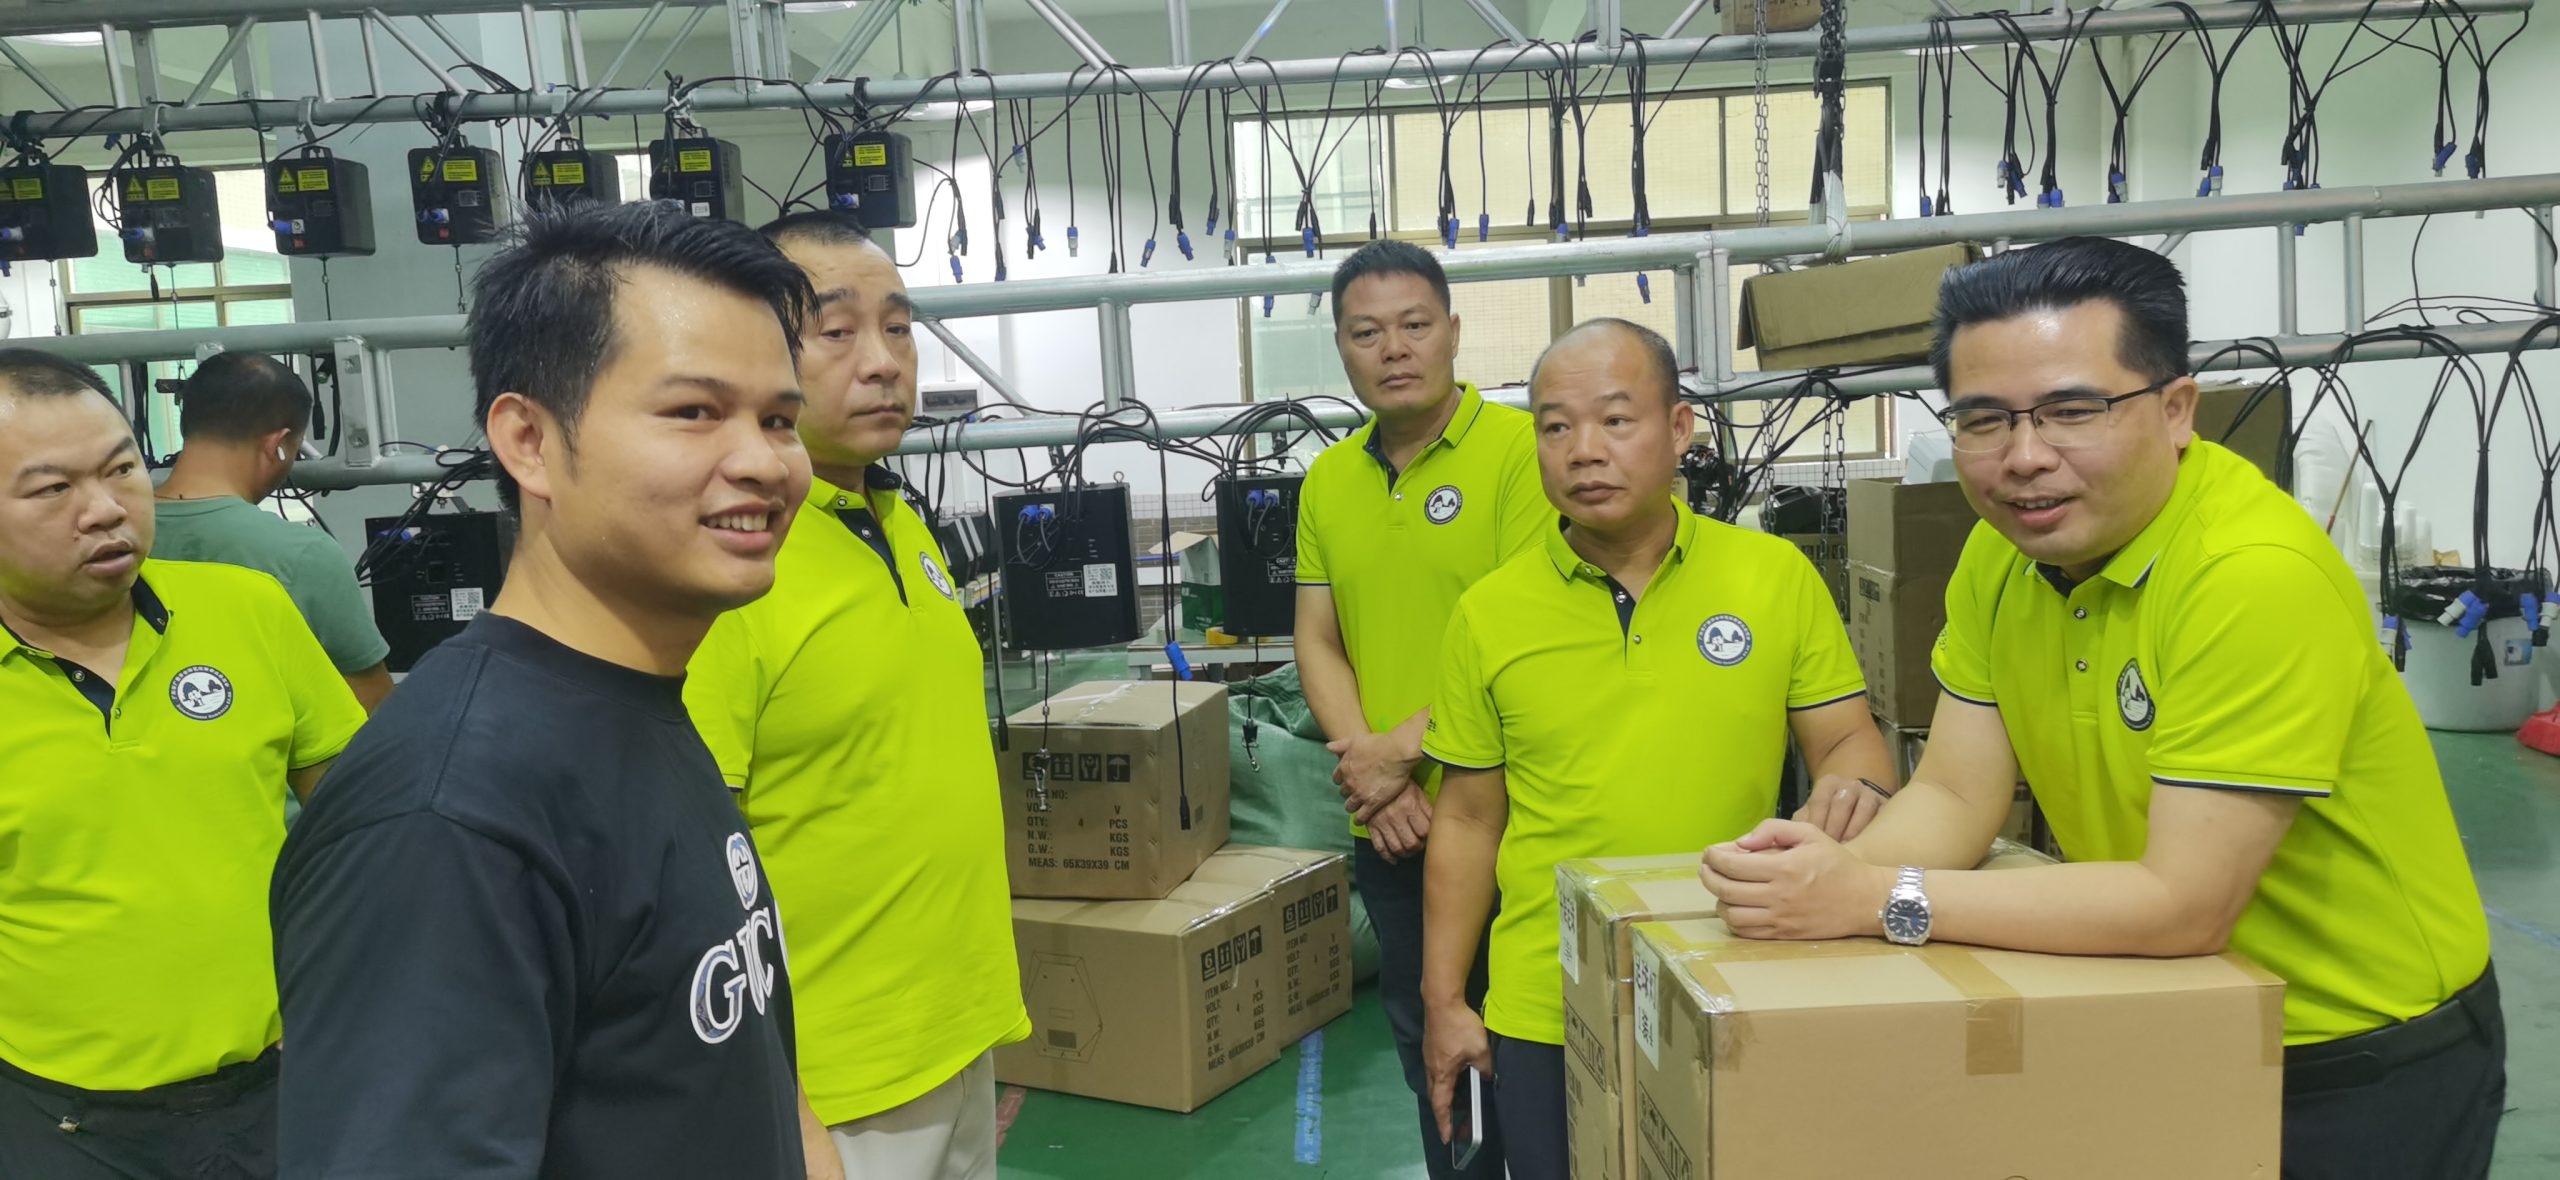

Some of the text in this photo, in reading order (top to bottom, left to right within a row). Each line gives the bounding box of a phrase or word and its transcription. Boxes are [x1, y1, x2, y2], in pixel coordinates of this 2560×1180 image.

[1114, 805, 1121, 815] V
[1027, 816, 1128, 829] QTY: 4 PCS
[1110, 832, 1129, 843] KGS
[1110, 846, 1130, 857] KGS
[1028, 857, 1058, 868] MEAS:
[1114, 860, 1130, 870] CM
